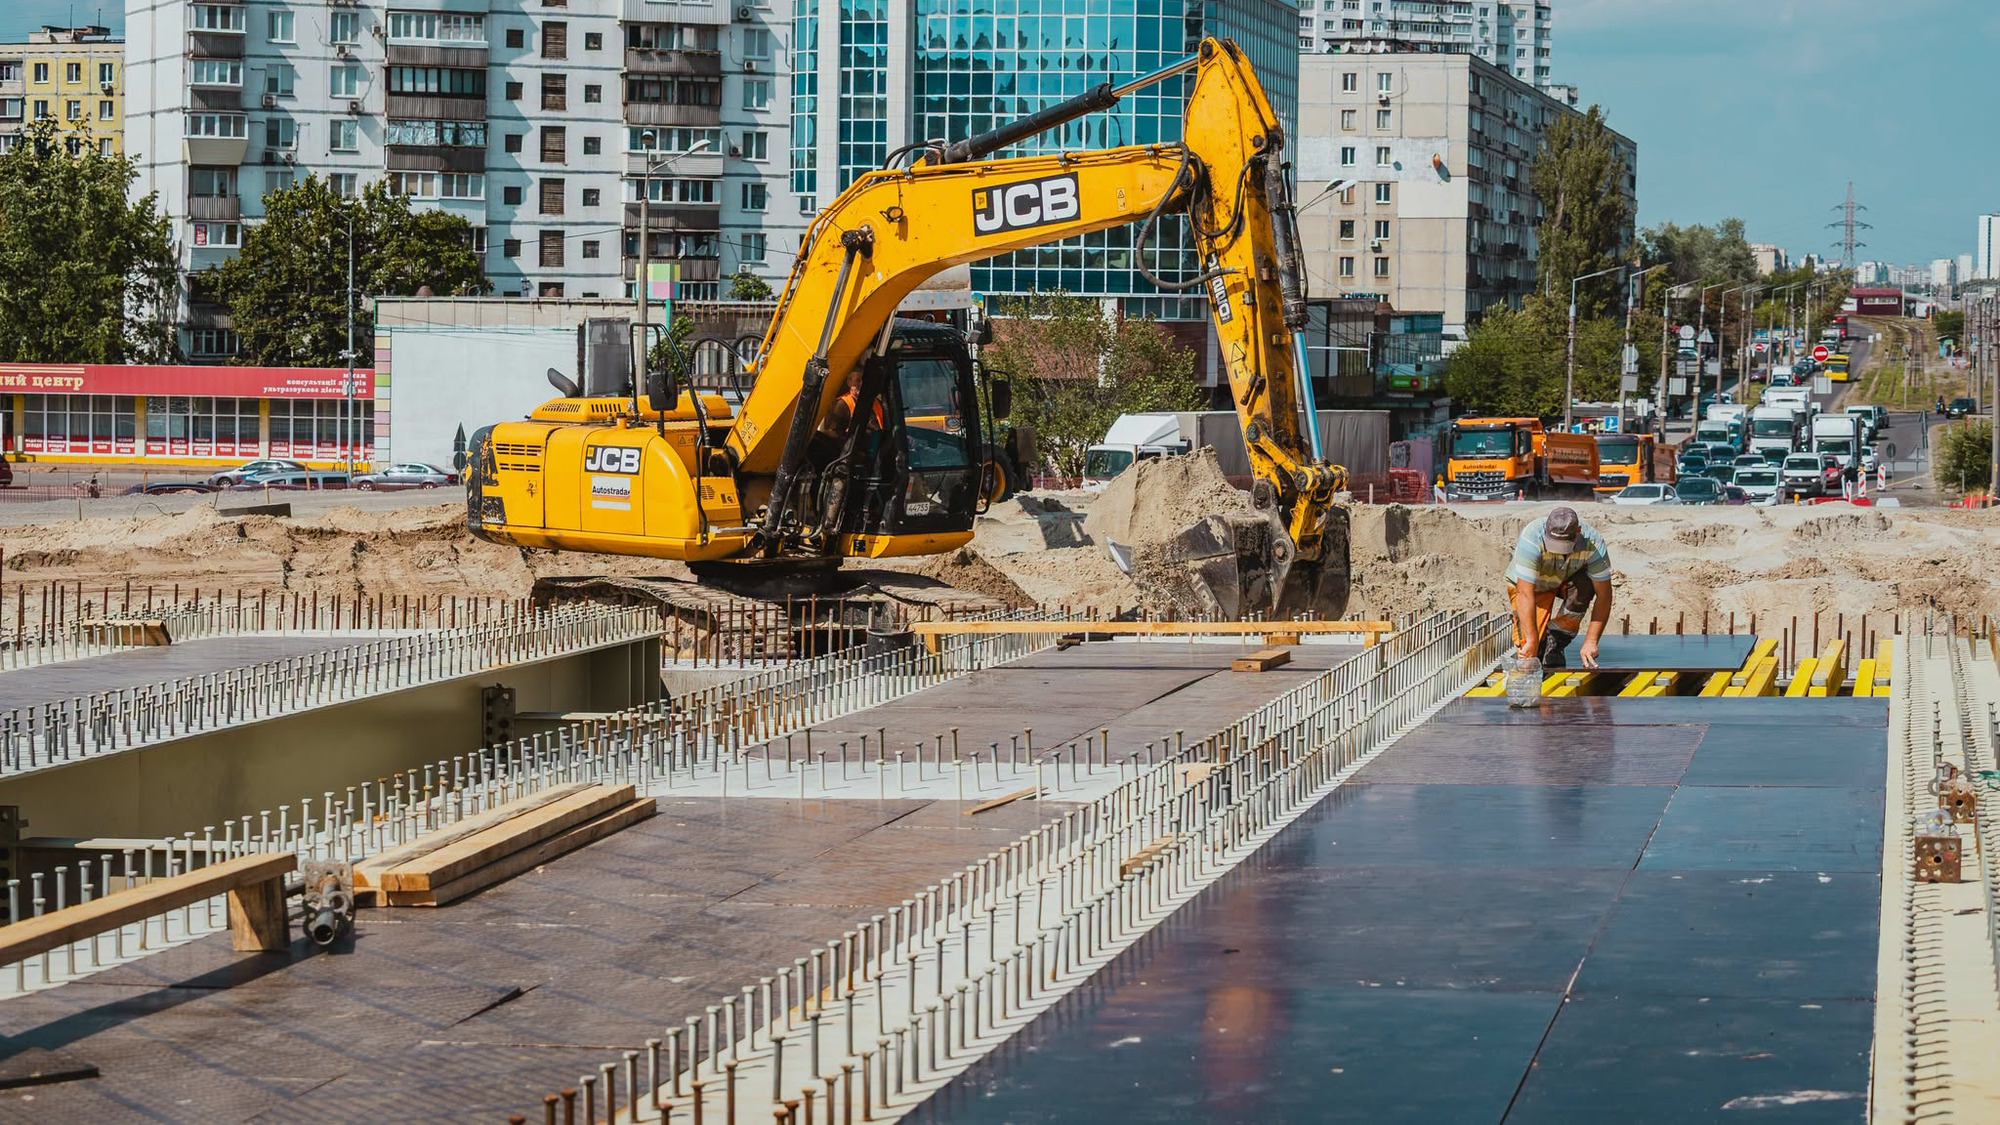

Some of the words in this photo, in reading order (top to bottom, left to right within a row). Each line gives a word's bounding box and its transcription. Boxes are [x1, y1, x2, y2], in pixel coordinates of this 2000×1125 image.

[975, 177, 1078, 232] JCB
[32, 376, 84, 391] центр
[586, 447, 640, 473] JCB
